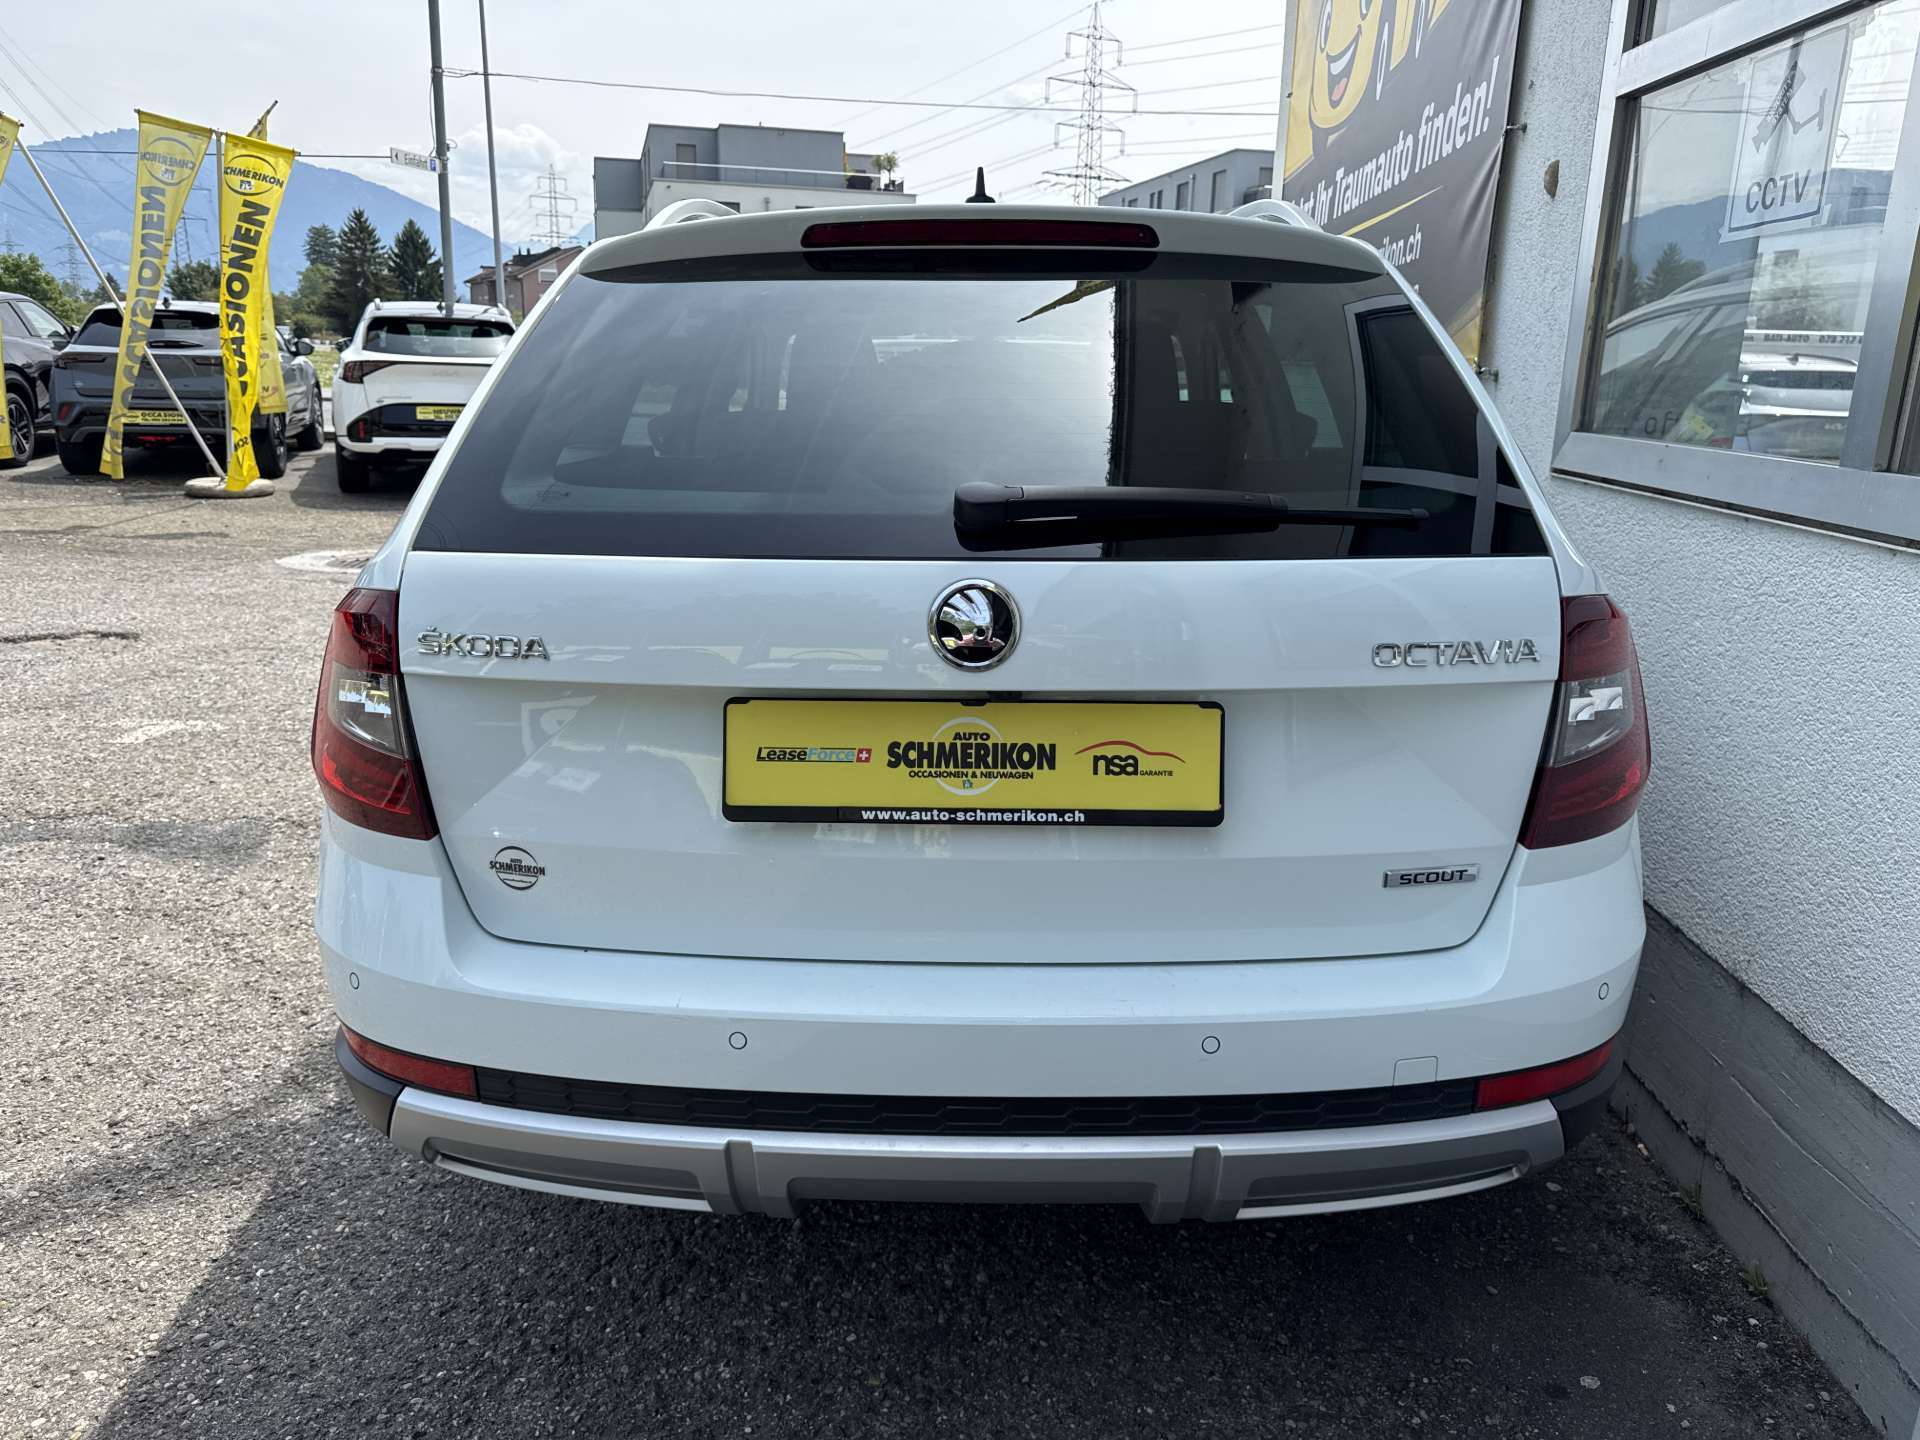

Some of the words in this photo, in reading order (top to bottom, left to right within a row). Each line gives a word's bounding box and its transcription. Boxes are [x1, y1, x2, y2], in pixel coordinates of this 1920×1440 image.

[1315, 180, 1333, 226] Ihr
[1333, 130, 1413, 219] Traumauto
[1415, 55, 1500, 173] finden!
[1745, 168, 1811, 214] CCTV
[417, 626, 550, 660] ŠKODA
[1372, 639, 1542, 667] OCTAVIA
[952, 732, 991, 741] AUTO
[756, 747, 856, 762] LeaseForce
[886, 741, 1057, 771] SCHMERIKON
[908, 770, 969, 779] OCCASIONEN
[970, 770, 978, 779] &
[979, 771, 1034, 780] NEUWAGEN
[1092, 754, 1139, 776] nsa
[1139, 769, 1174, 777] GARANTIE
[861, 809, 1085, 823] www.auto-schmerikon.ch
[489, 860, 546, 876] SCHMERIKON
[1399, 869, 1469, 885] SCOUT
